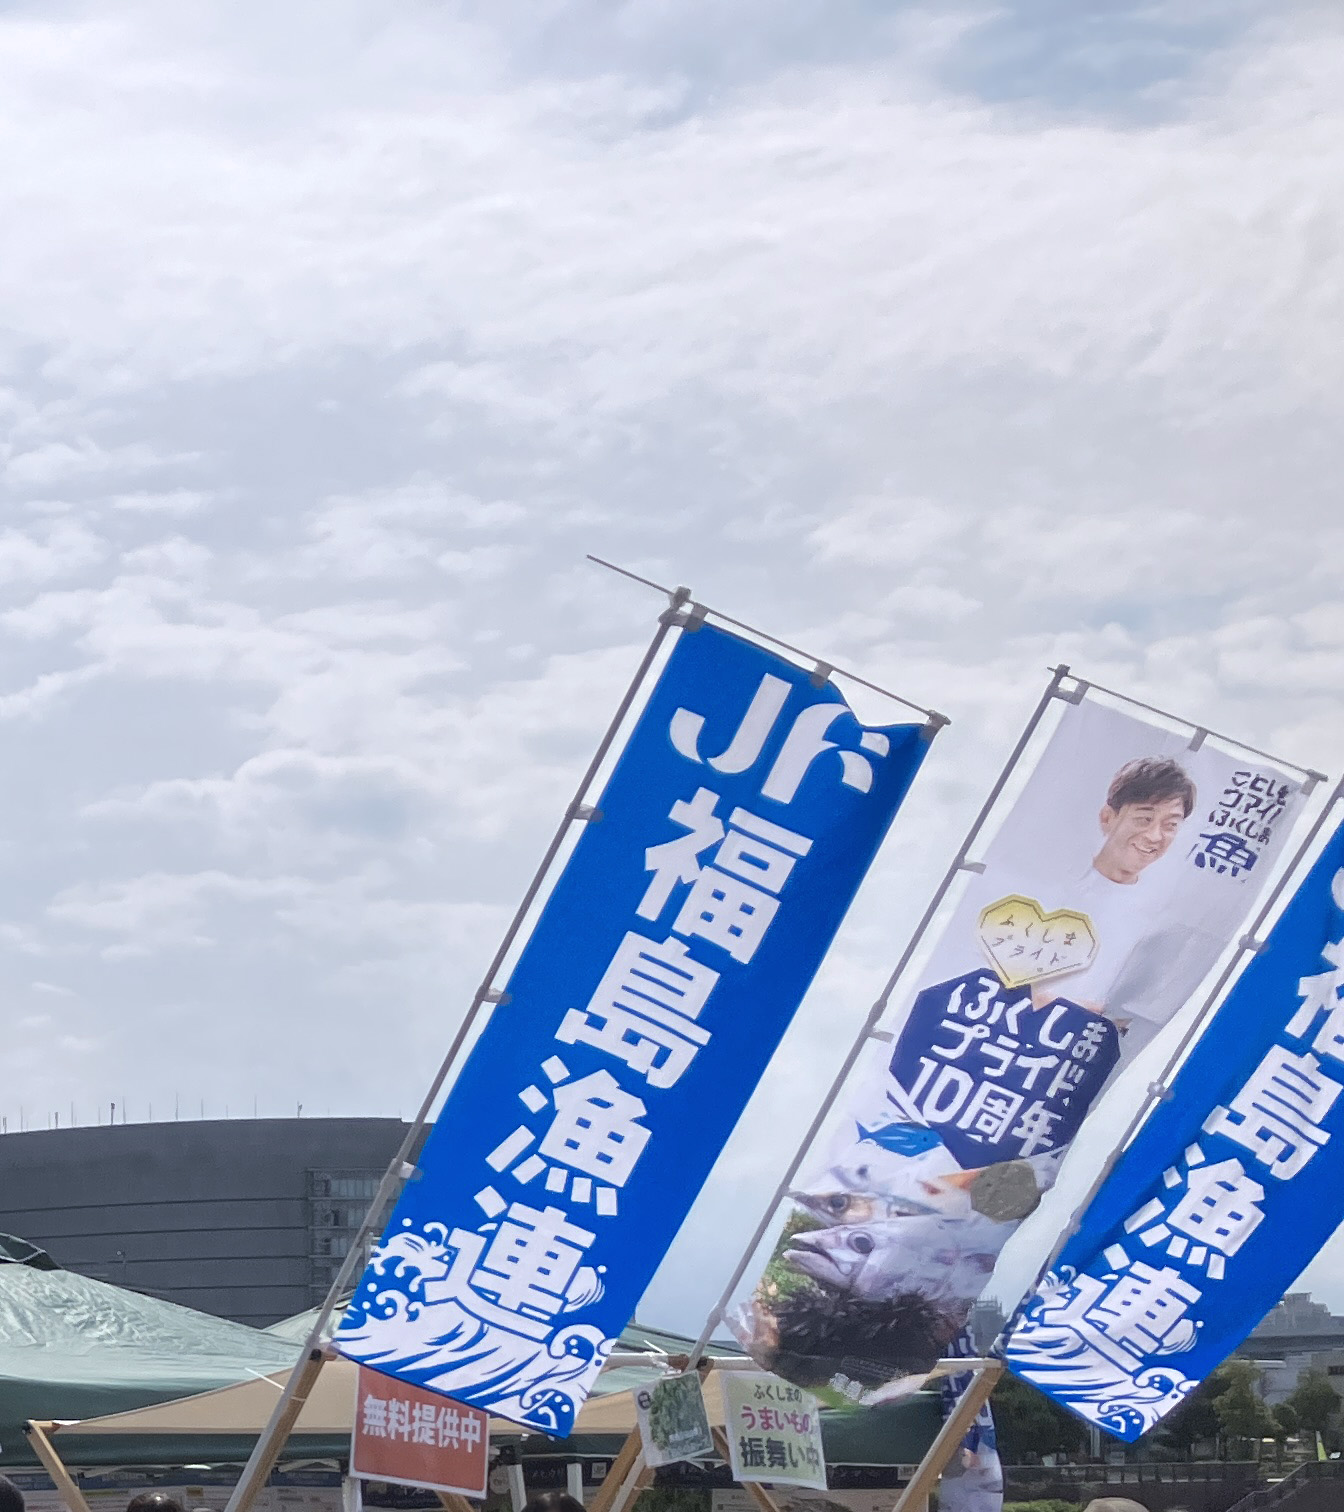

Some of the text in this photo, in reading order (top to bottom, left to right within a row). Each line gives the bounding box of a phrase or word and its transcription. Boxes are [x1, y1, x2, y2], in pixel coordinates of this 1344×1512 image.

[946, 976, 1108, 1062] ふくしま
[910, 1056, 1063, 1157] 10周年
[753, 1383, 803, 1403] ふくしまの
[362, 1393, 481, 1454] 無料提供中
[741, 1404, 811, 1434] うまいもの
[739, 1435, 820, 1475] 振舞い中
